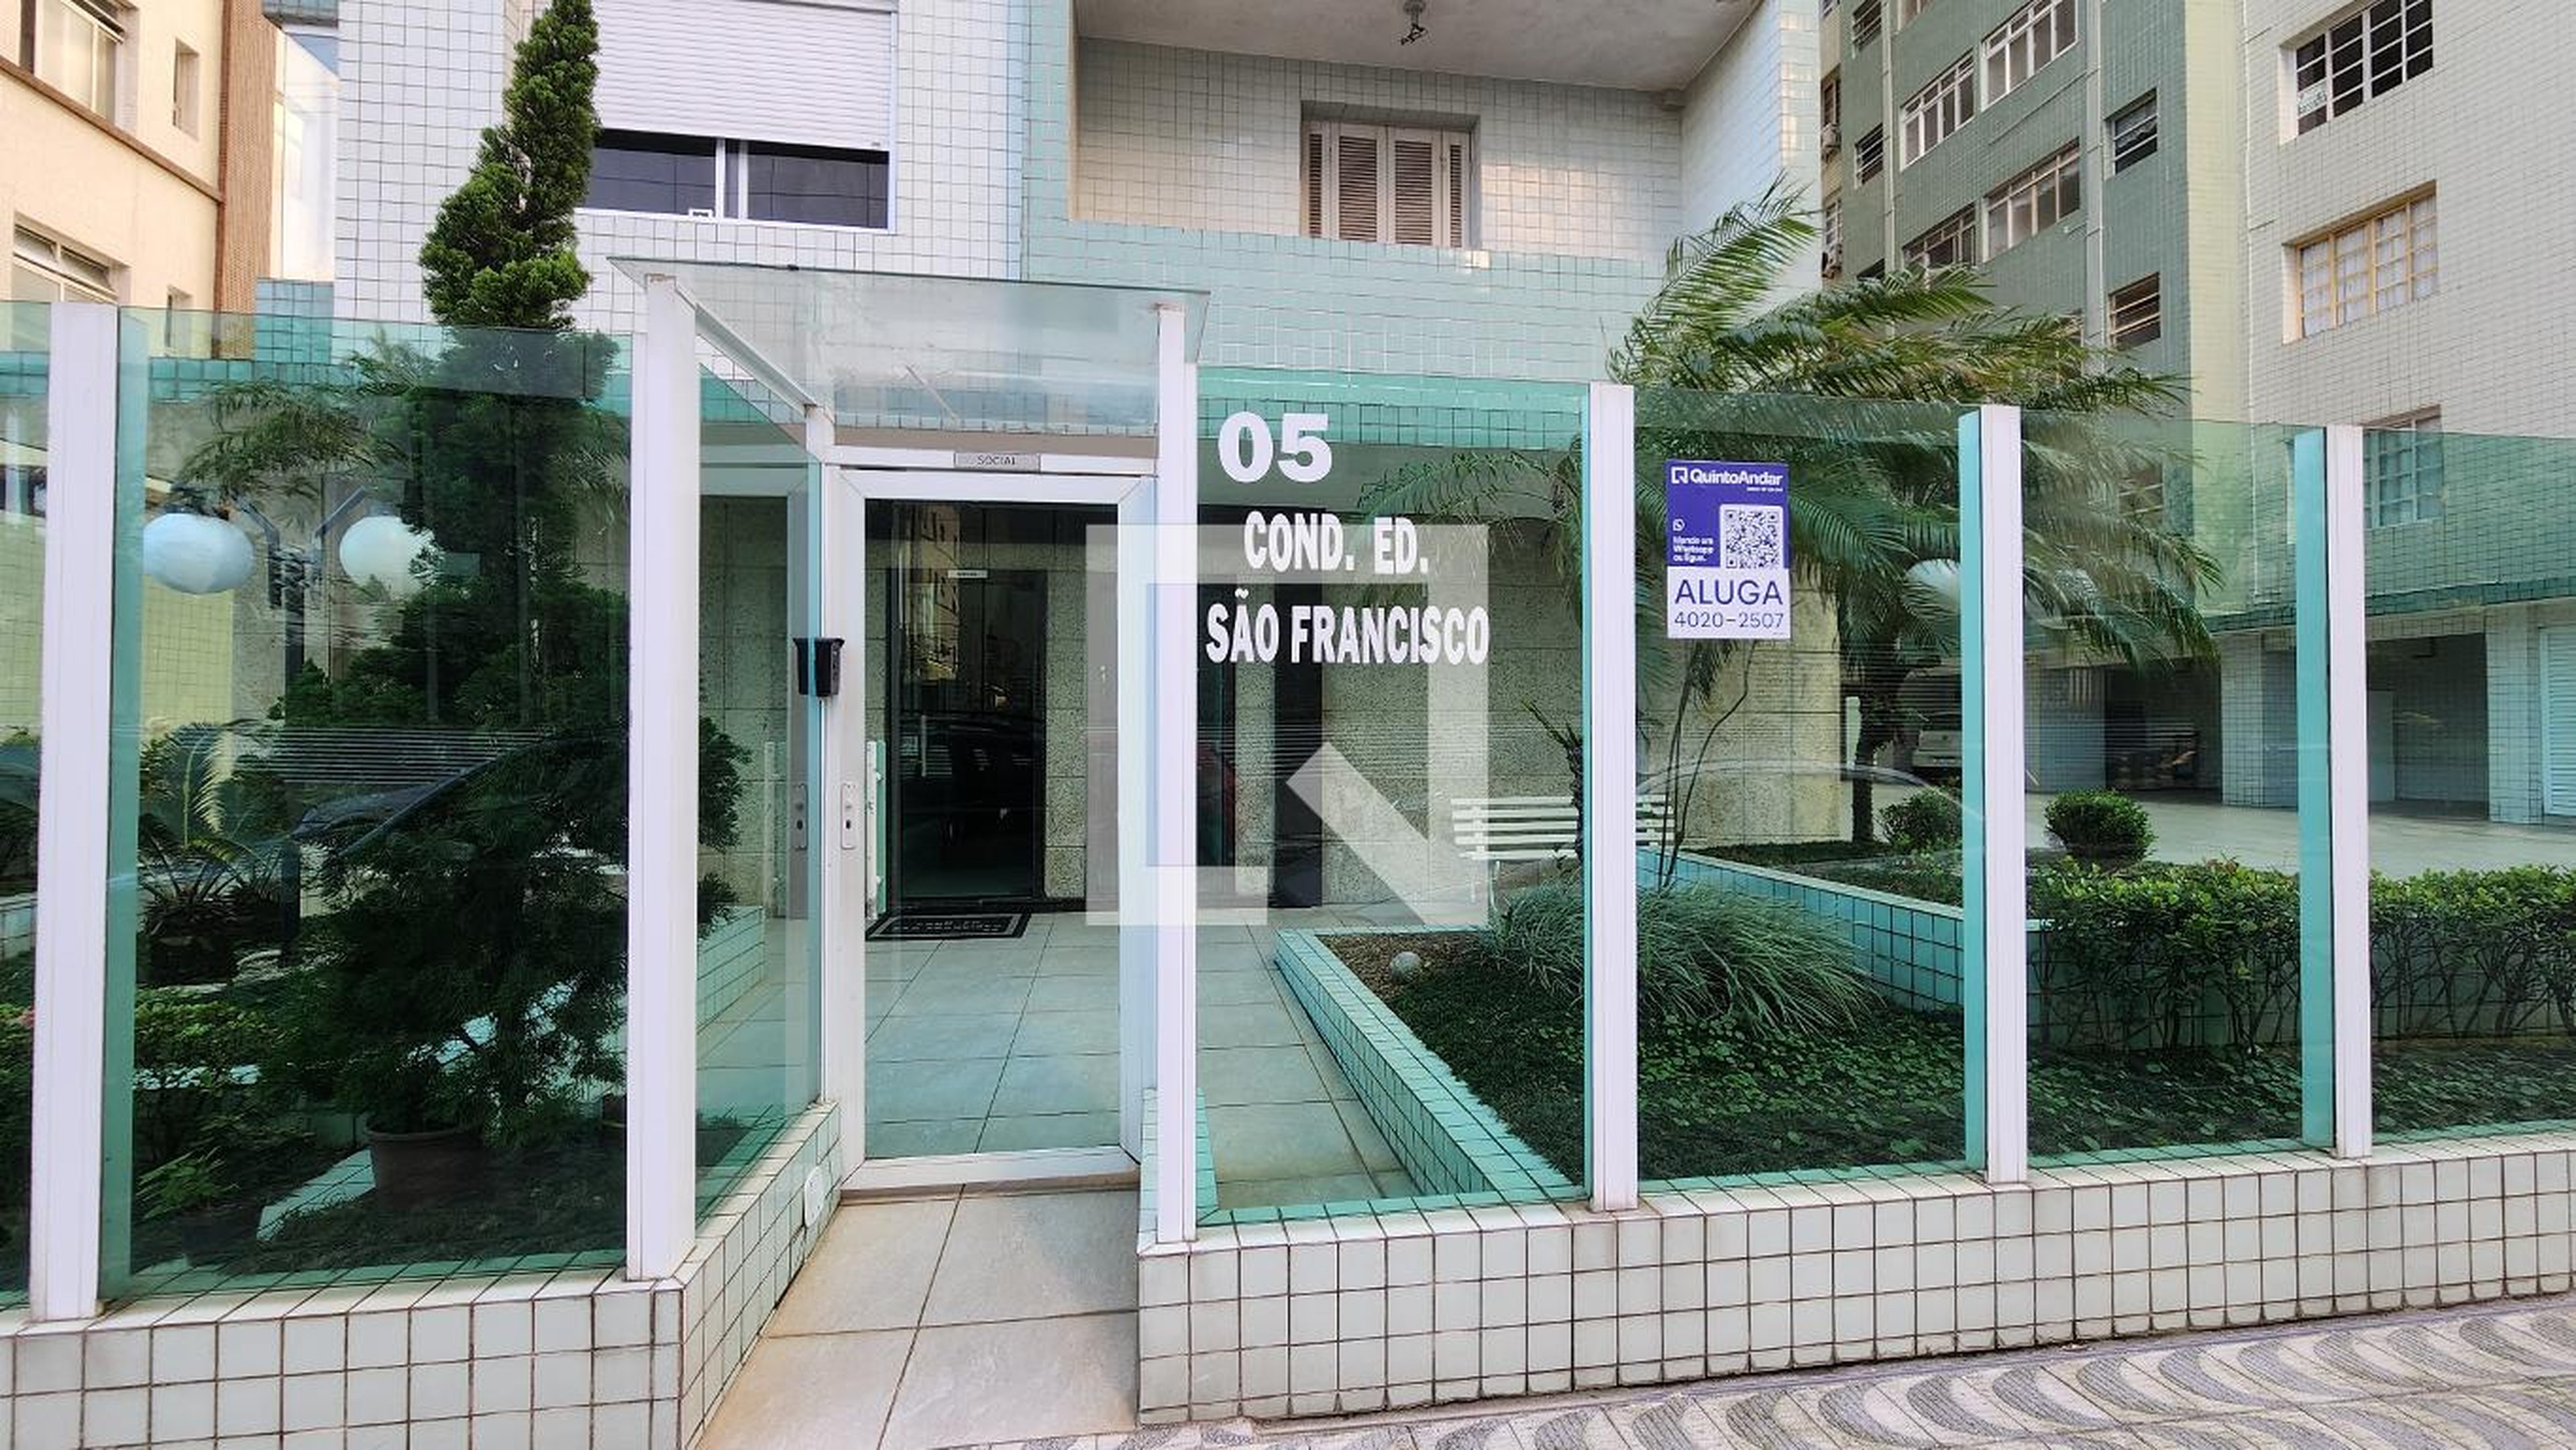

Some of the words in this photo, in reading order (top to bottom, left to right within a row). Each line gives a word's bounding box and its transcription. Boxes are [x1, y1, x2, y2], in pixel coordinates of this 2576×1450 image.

[977, 454, 1016, 465] SOCIAL
[1218, 411, 1332, 483] 05
[1690, 469, 1783, 486] QuintoAndar
[1244, 510, 1356, 572] COND.
[1373, 516, 1429, 574] ED.
[1675, 579, 1783, 605] ALUGA
[1207, 588, 1279, 663] SÃO
[1291, 606, 1490, 665] FRANCISCO
[1674, 611, 1784, 628] 4020-2507
